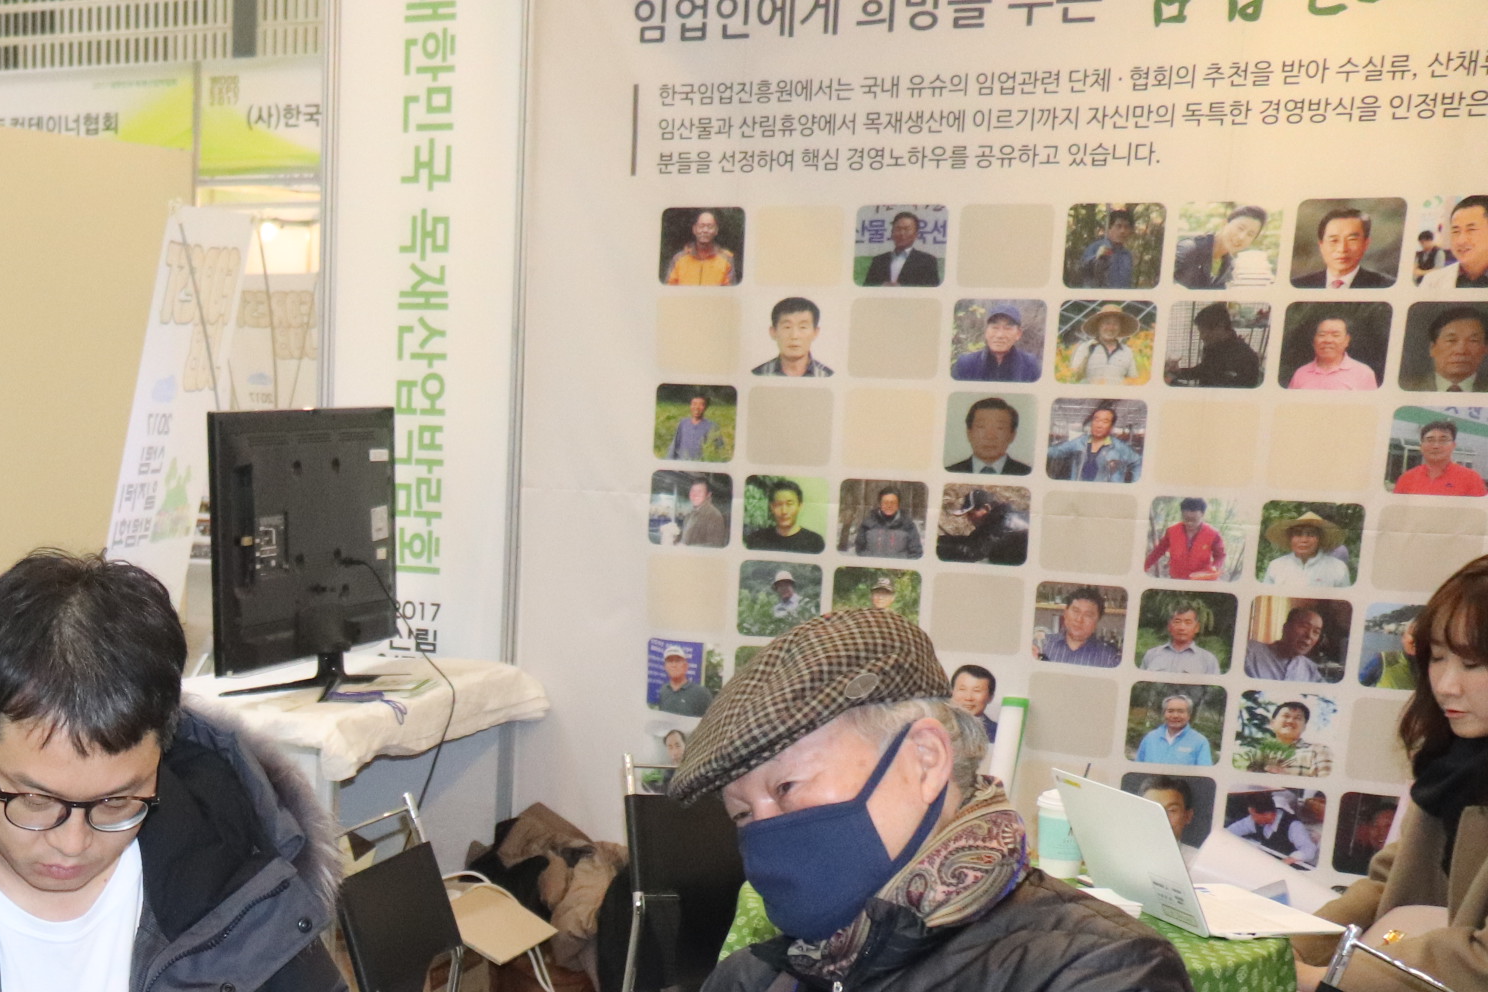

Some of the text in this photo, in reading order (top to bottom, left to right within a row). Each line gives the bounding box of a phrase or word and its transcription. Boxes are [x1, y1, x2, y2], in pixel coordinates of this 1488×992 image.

[634, 0, 838, 43] 임업인에게
[659, 78, 855, 106] 한국임업진흥원에서는
[860, 75, 900, 99] 국내
[976, 70, 1061, 96] 임업관련
[1068, 67, 1112, 93] 단체
[1129, 64, 1196, 92] 협회의
[1203, 60, 1275, 88] 추천을
[1281, 58, 1330, 85] 받아
[1335, 54, 1417, 82] 수실류,
[658, 90, 1488, 141] 임산물과 산림휴양에서 목재생산에 이르기까지 자신만의 독특한 경영방식을 인정받은
[657, 141, 1161, 174] 분들을 선정하여 핵심 경영노하우를 공유하고 있습니다.
[394, 208, 452, 575] 목재산업박람회
